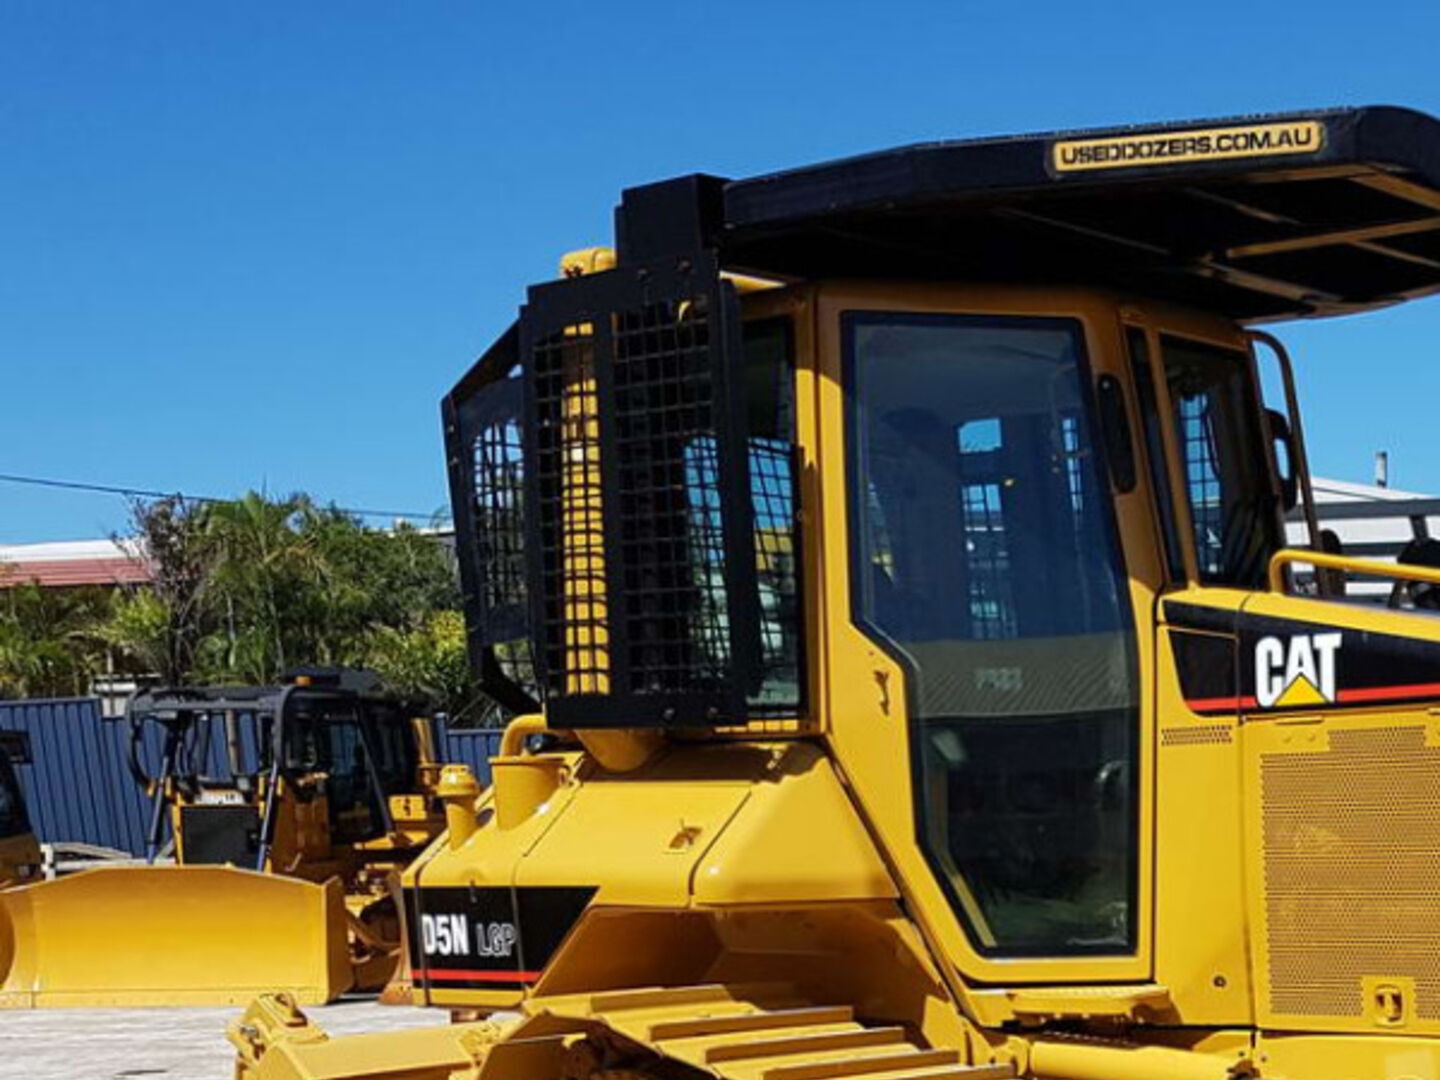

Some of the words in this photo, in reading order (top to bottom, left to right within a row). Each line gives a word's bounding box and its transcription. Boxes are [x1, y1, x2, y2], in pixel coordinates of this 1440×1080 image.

[1059, 127, 1312, 165] USEDDOZERS.COM.AU
[1255, 632, 1342, 707] CAT
[421, 913, 469, 955] D5N
[475, 922, 516, 956] LGP
